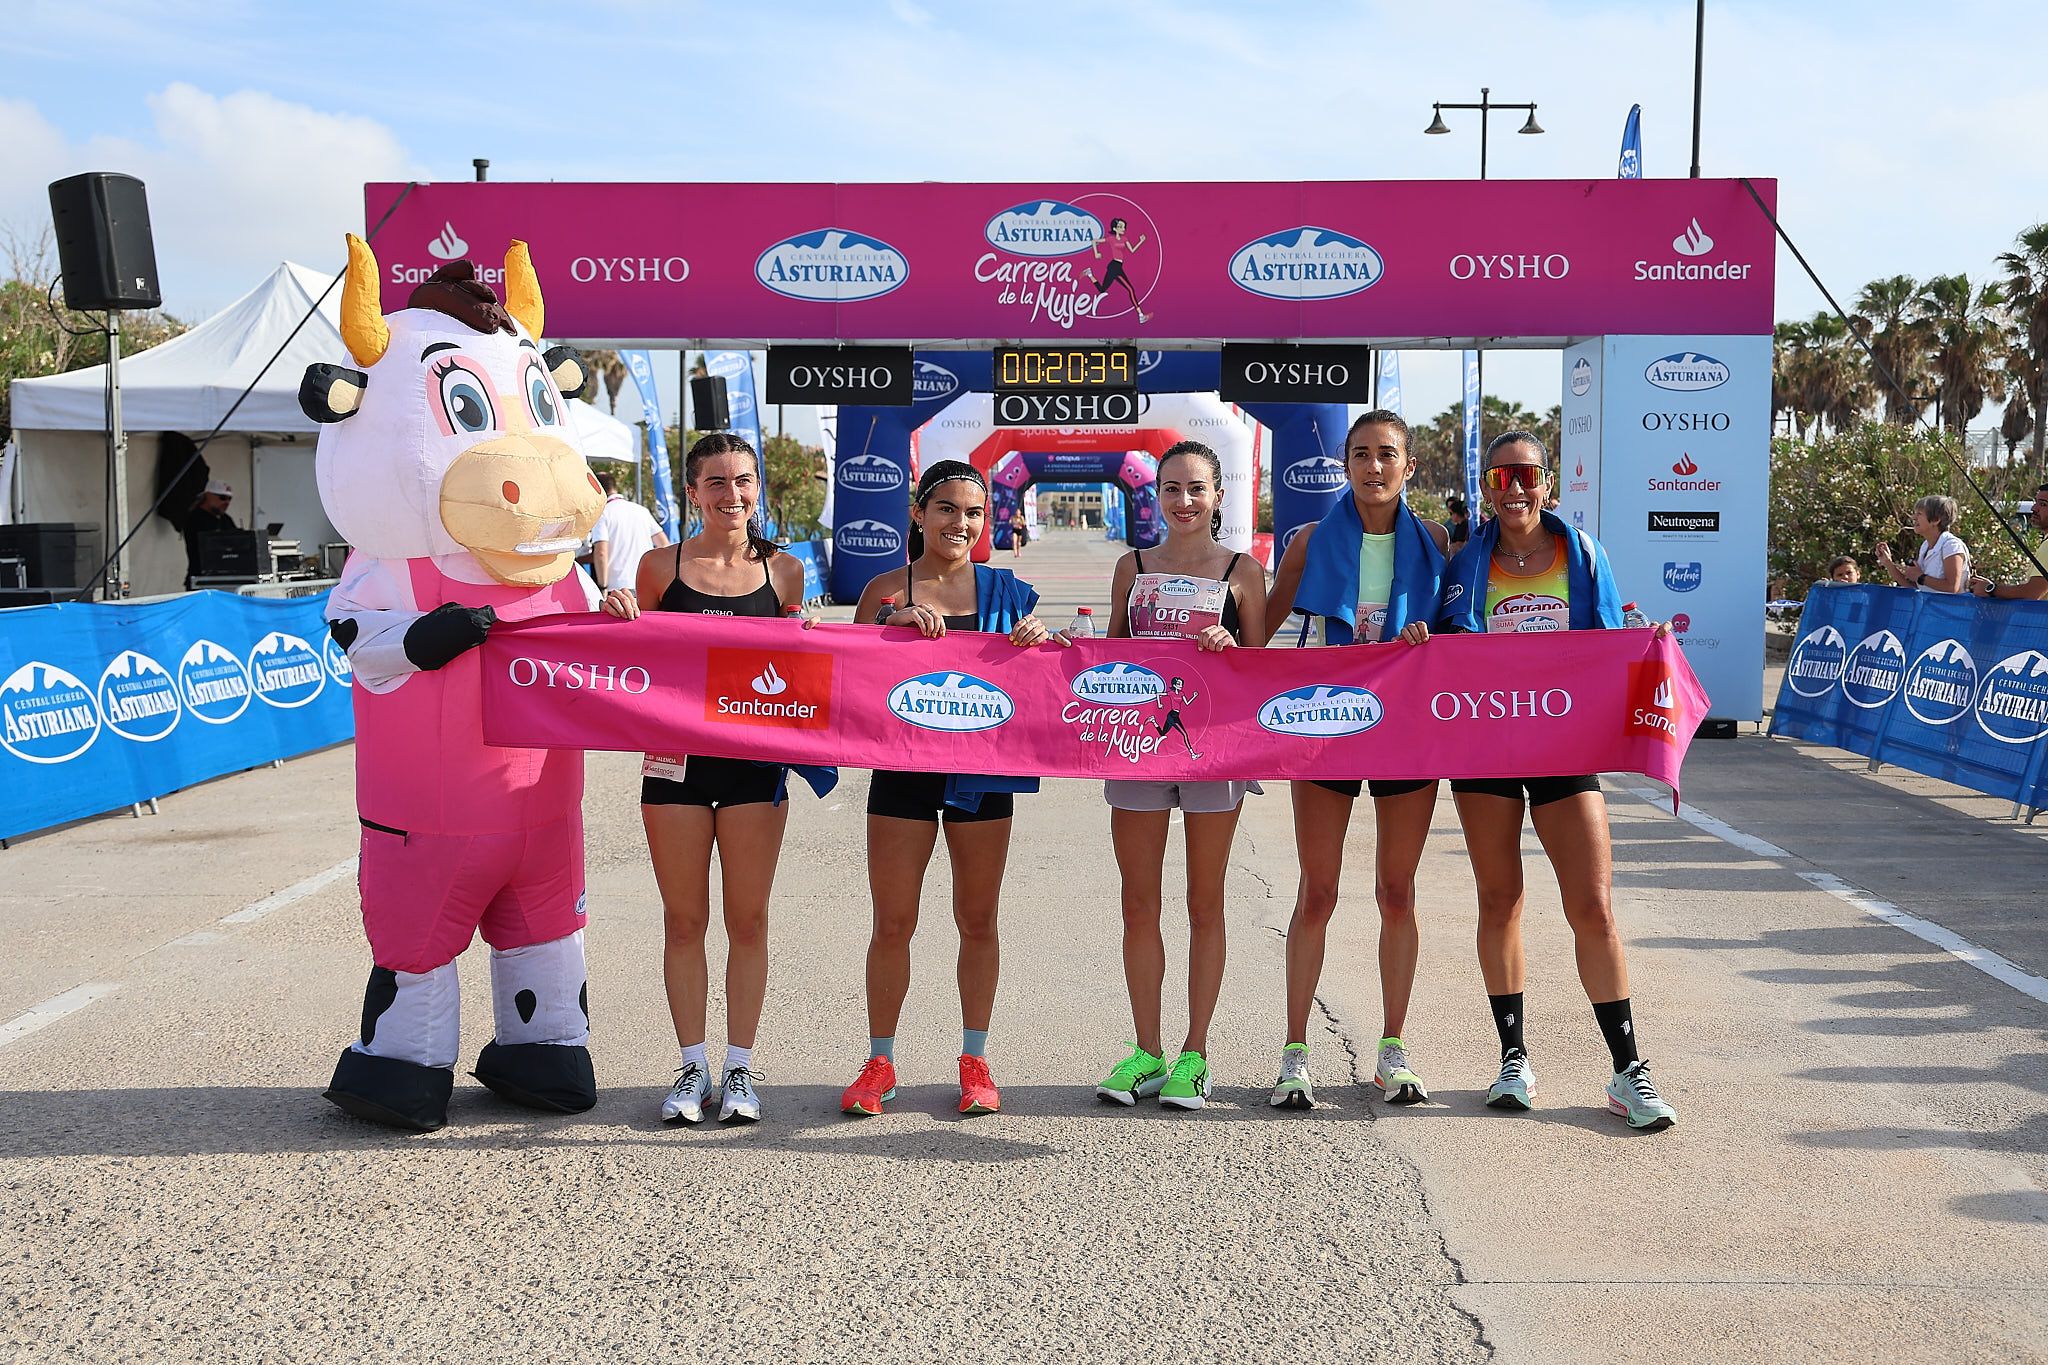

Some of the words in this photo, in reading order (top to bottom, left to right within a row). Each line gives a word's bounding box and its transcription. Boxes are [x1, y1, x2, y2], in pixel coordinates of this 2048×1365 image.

[994, 221, 1095, 243] ASTURIANA
[790, 253, 837, 262] CENTRAL
[843, 253, 893, 262] LECHERA
[1264, 252, 1309, 261] CENTRAL
[1312, 251, 1368, 260] LECHERA
[1449, 254, 1570, 280] OYSHO
[392, 263, 505, 285] Sander
[570, 256, 690, 283] OYSHO
[767, 258, 898, 284] ASTURIANA
[974, 253, 1072, 284] Carrera
[1241, 254, 1372, 282] ASTURIANA
[1634, 260, 1751, 282] Santander
[998, 284, 1016, 305] de
[1019, 283, 1034, 305] la
[1030, 281, 1108, 329] Mujer
[789, 366, 893, 390] OYSHO
[1003, 352, 1128, 384] 00:20:39
[1244, 362, 1349, 387] OYSHO
[1651, 367, 1723, 383] ASTURIANA
[914, 380, 951, 392] RIANA
[1000, 394, 1132, 422] OYSHO
[941, 419, 981, 429] OYSHO
[1189, 418, 1228, 427] OYSHO
[1569, 414, 1592, 435] OYSHO
[1642, 412, 1731, 431] OYSHO
[841, 467, 899, 484] ASTURIANA
[1224, 473, 1246, 482] SHO
[1288, 470, 1346, 484] ASTURIAN
[1648, 478, 1721, 491] Santander
[1653, 515, 1715, 530] Neutrogena
[840, 532, 897, 548] ASTURIANA
[1665, 568, 1700, 584] Marlene
[1162, 585, 1196, 594] ASTURIANA
[1155, 608, 1190, 623] 016
[1499, 602, 1563, 615] Serrano
[1520, 623, 1557, 632] ASTURIANA
[509, 657, 651, 694] OYSHO
[1792, 651, 1840, 681] ASTURIANA
[1845, 655, 1898, 692] ASTURIANA
[1924, 665, 1947, 676] CENTRAL
[1948, 668, 1972, 682] LECHERA
[116, 681, 141, 694] CENTRAL
[256, 662, 321, 694] ASTURIANA
[1078, 677, 1158, 695] ASTURIANA
[1908, 667, 1969, 707] ASTURIANA
[1998, 678, 2026, 691] CENTRAL
[2028, 681, 2048, 694] LECH
[14, 697, 50, 710] CENTRAL
[53, 692, 85, 705] LECHERA
[187, 674, 248, 707] ASTURIANA
[917, 689, 957, 699] CENTRAL
[960, 692, 1001, 702] LECHERA
[108, 688, 178, 724] ASTURIANA
[718, 697, 817, 719] Santander
[897, 690, 1004, 720] ASTURIANA
[1061, 701, 1141, 727] Carrera
[1267, 704, 1374, 726] ASTURIANA
[1286, 701, 1326, 711] CENTRAL
[1330, 698, 1371, 707] LECHERA
[1430, 688, 1572, 722] OYSHO
[4, 704, 96, 744] ASTURIANA
[1079, 727, 1095, 742] de
[1098, 726, 1108, 742] la
[1106, 722, 1167, 763] Mujer
